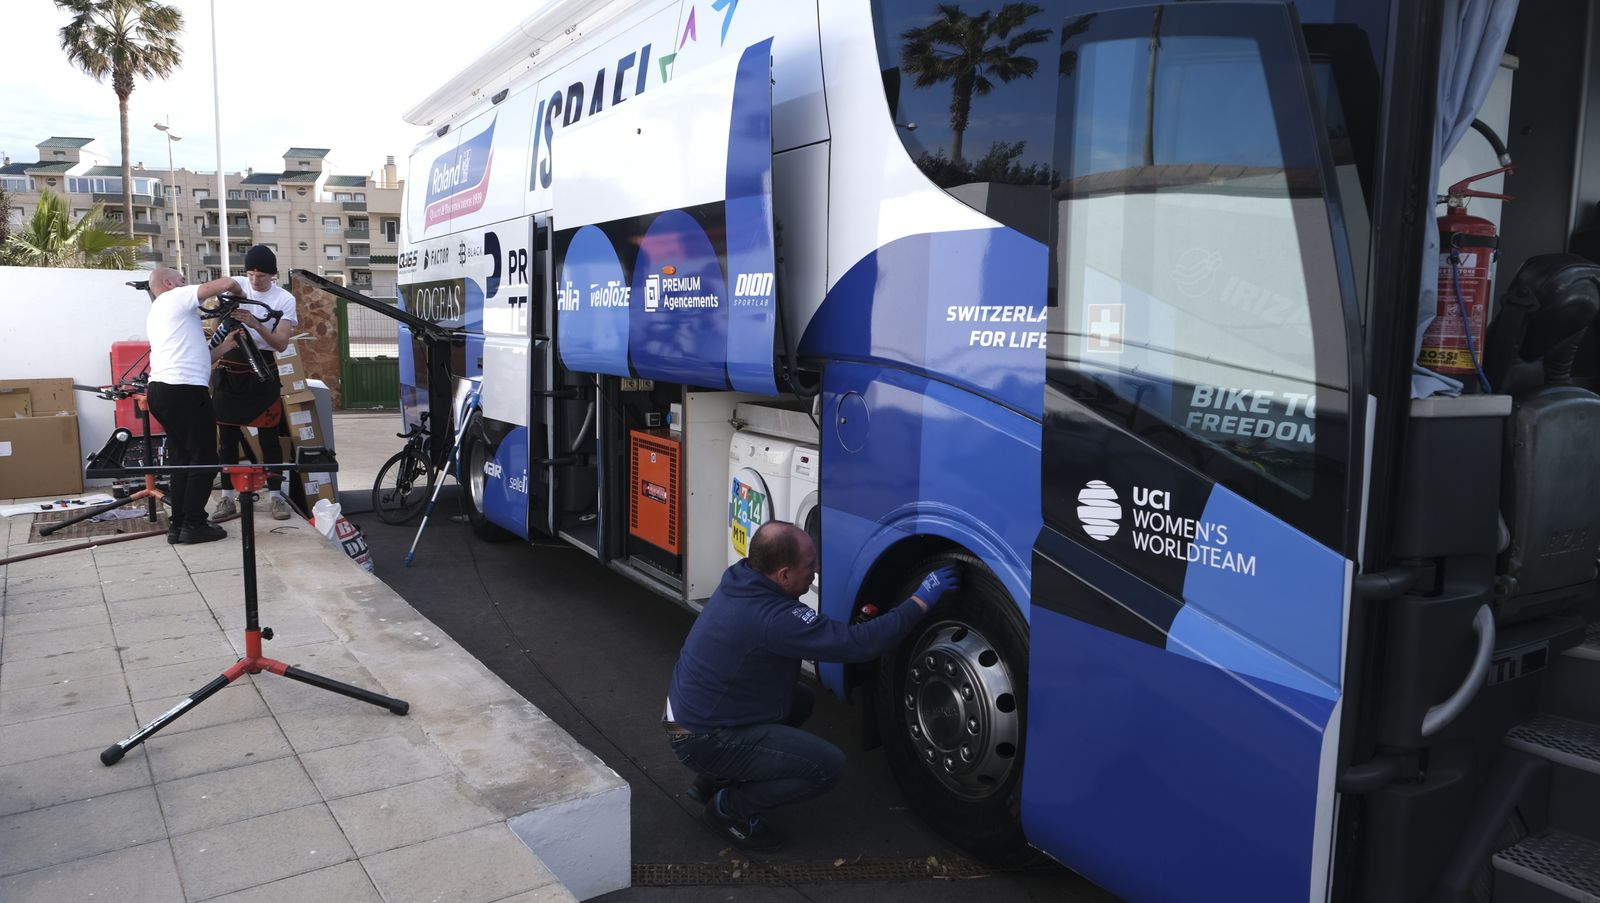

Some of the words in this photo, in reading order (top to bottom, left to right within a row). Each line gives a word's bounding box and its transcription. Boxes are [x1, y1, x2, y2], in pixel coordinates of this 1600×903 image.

[432, 156, 462, 195] Roland
[431, 247, 449, 265] FACTOR
[467, 246, 483, 257] BLACK
[662, 276, 701, 292] PREMIUM
[735, 272, 774, 297] DION
[416, 285, 461, 321] COGEAS
[663, 293, 719, 308] Agencements
[946, 305, 1048, 322] SWITZERLA
[969, 330, 1006, 347] FOR
[1008, 331, 1047, 349] LIFE
[1190, 384, 1275, 415] BIKE
[1185, 411, 1316, 444] FREEDOM
[1132, 486, 1171, 511] UCI
[748, 500, 760, 523] 14
[1132, 508, 1228, 545] WOMEN'S
[1132, 530, 1257, 576] WORLDTEAM
